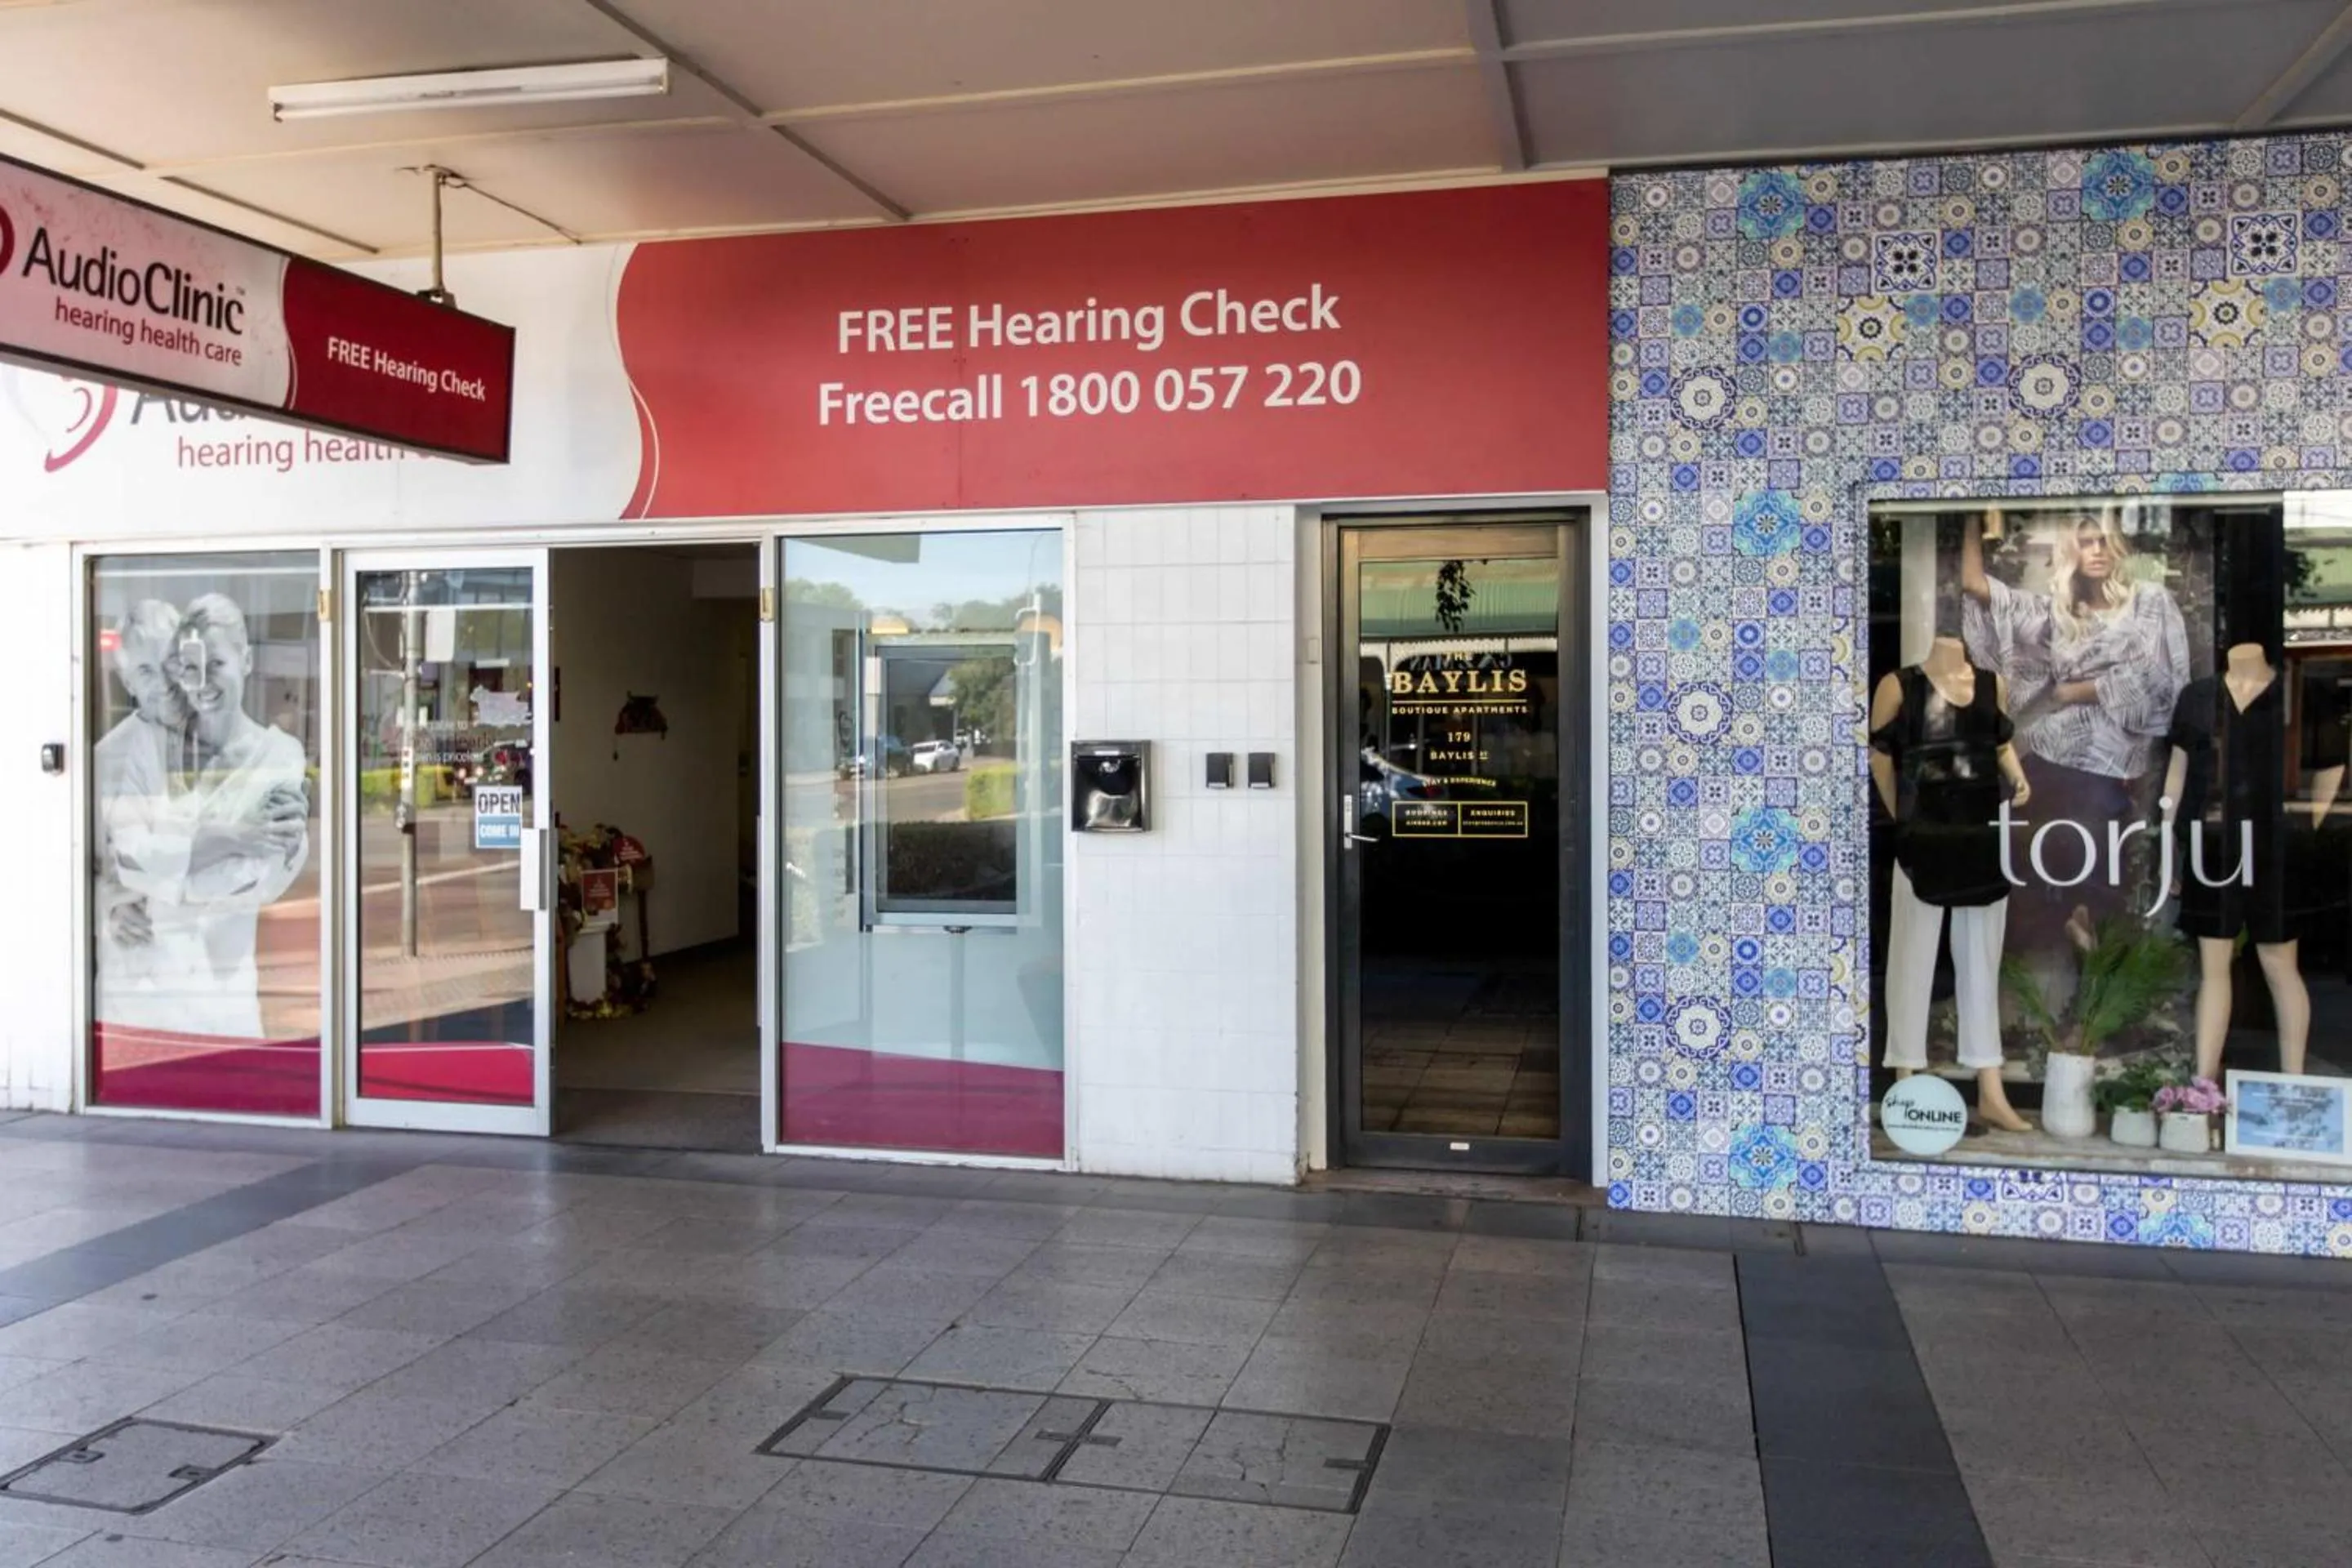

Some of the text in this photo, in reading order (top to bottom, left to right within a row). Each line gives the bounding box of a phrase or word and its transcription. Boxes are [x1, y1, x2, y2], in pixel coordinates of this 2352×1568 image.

[22, 226, 244, 336] AudioClinic
[55, 296, 243, 366] hearing health care
[838, 283, 1341, 353] FREE Hearing Check
[327, 336, 486, 402] FREE Hearing Check
[819, 360, 1361, 425] Freecall 1800 057 220
[178, 434, 293, 472] hearing
[1392, 670, 1526, 693] BAYLIS
[1392, 706, 1528, 715] BOUTIQUE APARTMENTS
[1447, 732, 1471, 742] 179
[1430, 751, 1474, 760] BAYLIS
[478, 793, 520, 813] OPEN
[479, 824, 507, 838] COME
[1988, 795, 2253, 918] torju
[1908, 1109, 1962, 1123] ONLINE
